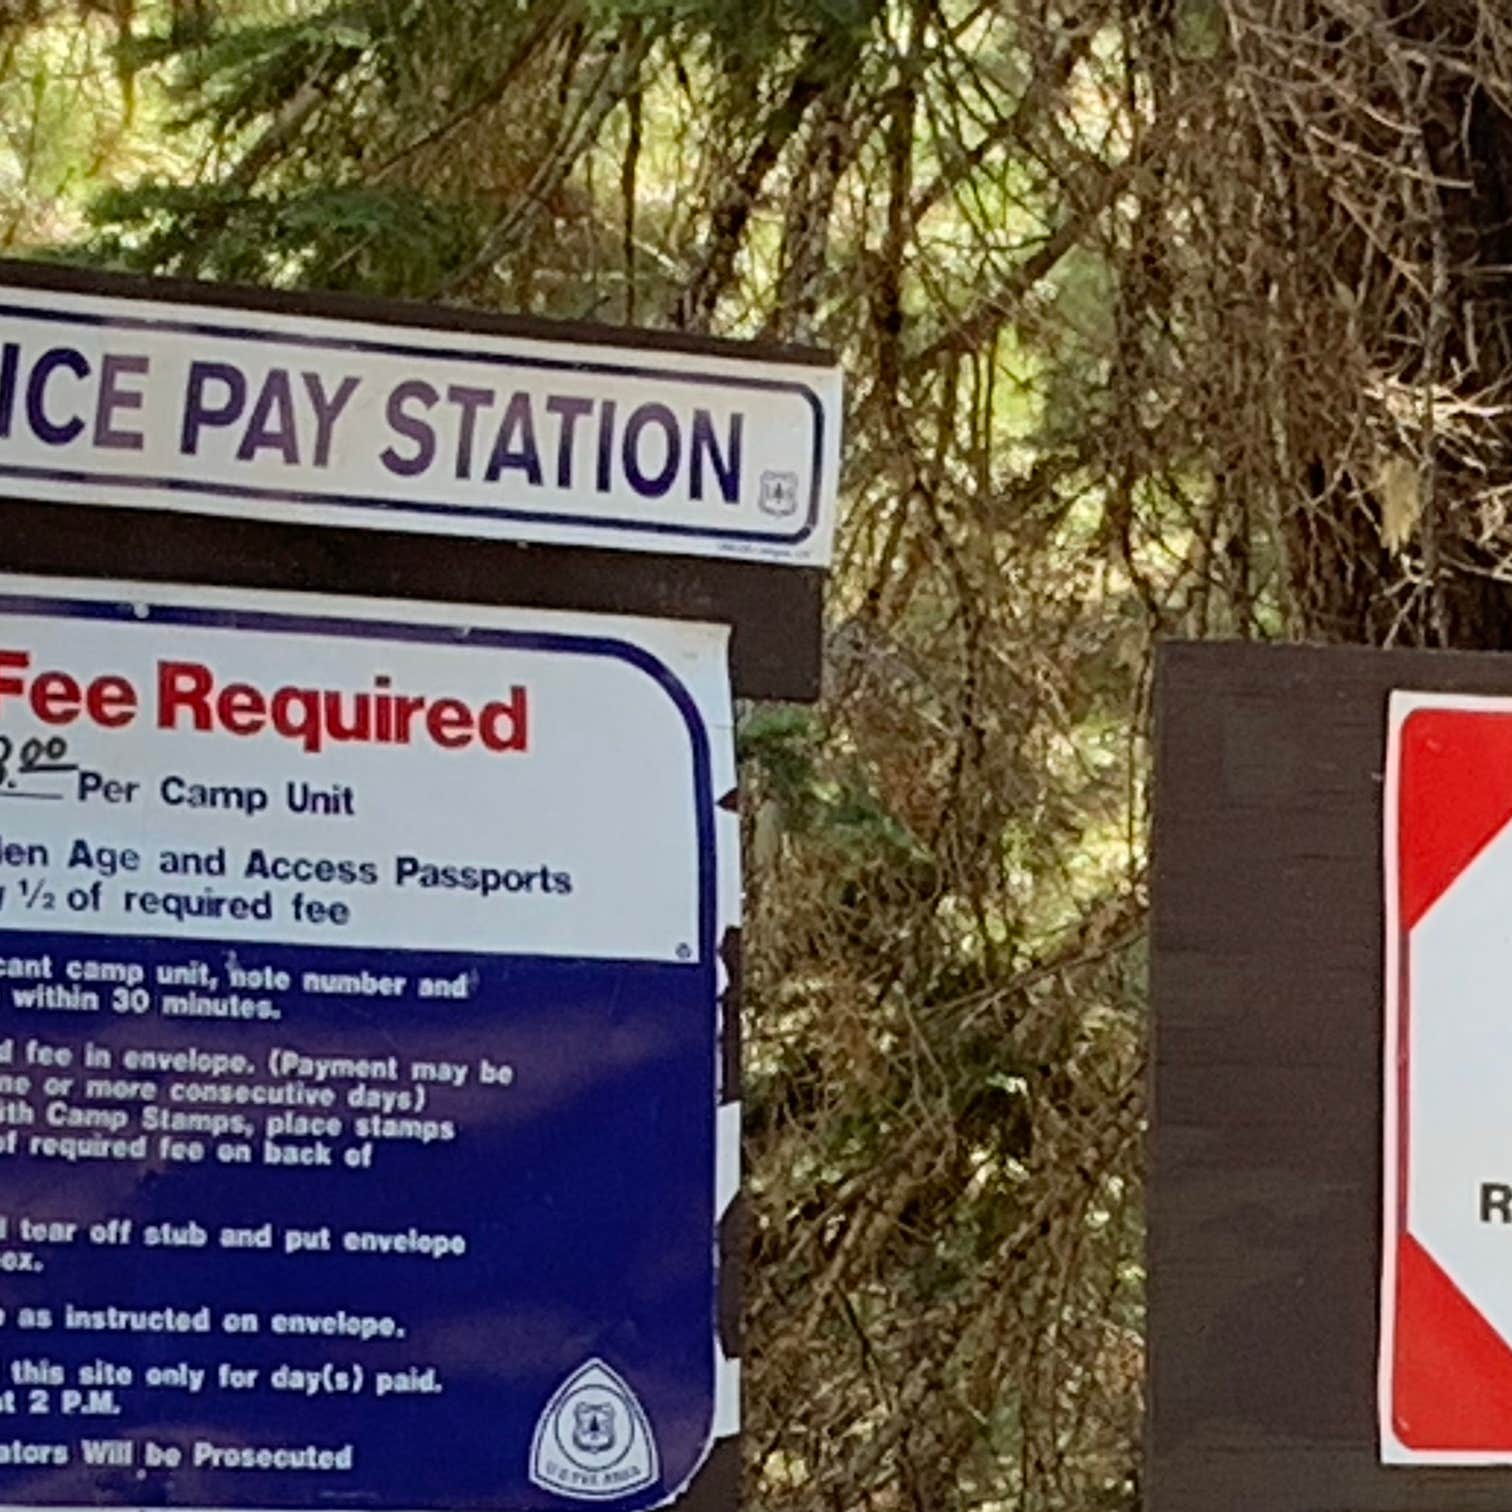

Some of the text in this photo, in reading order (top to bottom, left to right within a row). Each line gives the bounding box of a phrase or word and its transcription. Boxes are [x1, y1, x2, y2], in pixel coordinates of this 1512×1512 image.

[180, 360, 362, 467] PAY
[378, 379, 743, 506] STATION
[157, 659, 530, 753] Required
[78, 770, 355, 816] Per Camp Unit
[0, 836, 573, 898] en Age and Access Passports
[66, 881, 103, 912] of
[124, 887, 272, 922] required
[291, 892, 350, 925] fee
[66, 960, 145, 987] camp
[157, 960, 219, 990] unit,
[229, 966, 291, 991] note
[303, 969, 406, 999] number
[419, 973, 468, 999] and
[12, 984, 282, 1020] within 30 minutes.
[26, 1040, 73, 1067] fee
[85, 1042, 112, 1069] in
[123, 1048, 255, 1077] envelope.
[268, 1047, 397, 1085] (Payment
[411, 1059, 468, 1086] may
[480, 1057, 513, 1085] be
[44, 1077, 73, 1096] or
[86, 1079, 157, 1099] more
[170, 1078, 335, 1108] consecutive
[348, 1080, 427, 1112] days)
[46, 1101, 129, 1132] Camp
[142, 1106, 254, 1138] Stamps,
[267, 1111, 341, 1139] place
[356, 1114, 455, 1143] stamps
[30, 1133, 147, 1162] required
[160, 1136, 204, 1162] fee
[217, 1143, 251, 1163] on
[264, 1138, 331, 1166] back
[345, 1142, 372, 1168] of
[20, 1218, 76, 1242] tear
[90, 1219, 132, 1245] off
[144, 1221, 207, 1247] stub
[220, 1223, 272, 1248] and
[285, 1227, 330, 1254] put
[344, 1227, 466, 1257] envelope
[18, 1308, 52, 1328] as
[65, 1304, 210, 1332] instructed
[222, 1313, 258, 1332] on
[271, 1311, 406, 1340] envelope.
[10, 1358, 443, 1396] this site only for day(s) paid.
[28, 1389, 49, 1414] 2
[61, 1390, 121, 1415] P.M.
[81, 1439, 133, 1465] Will
[145, 1441, 182, 1467] be
[193, 1441, 353, 1470] Prosecuted
